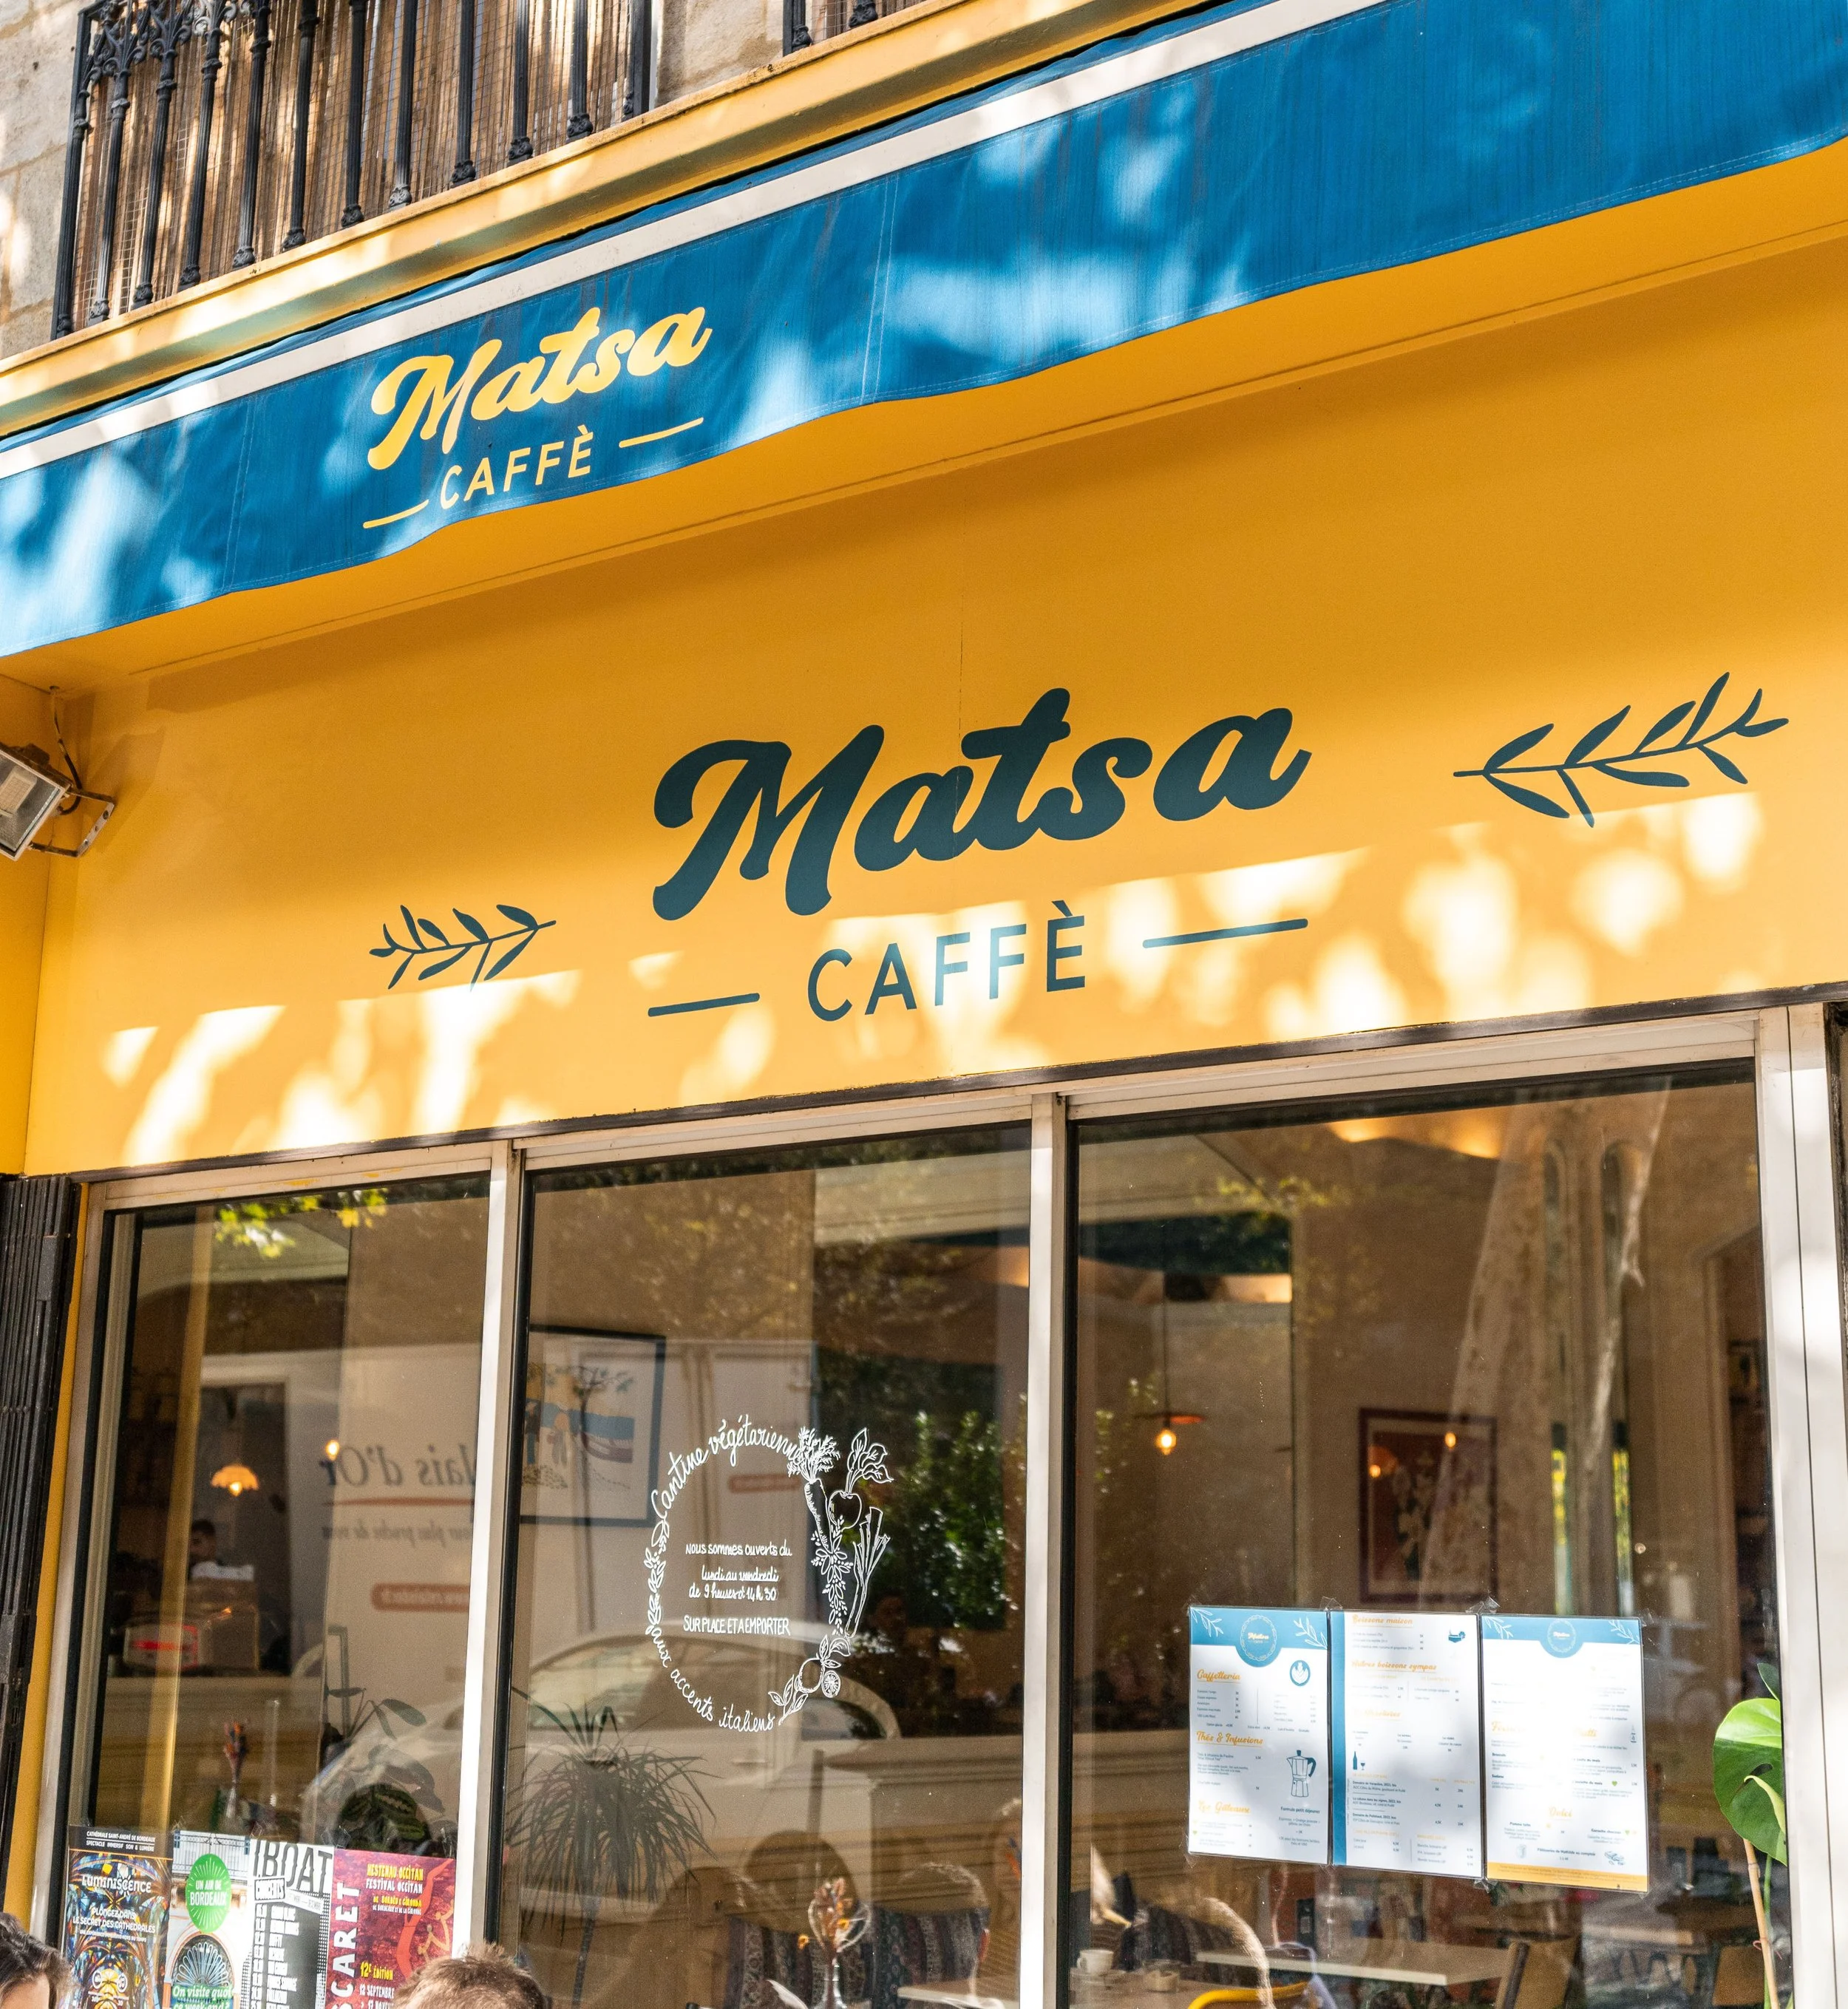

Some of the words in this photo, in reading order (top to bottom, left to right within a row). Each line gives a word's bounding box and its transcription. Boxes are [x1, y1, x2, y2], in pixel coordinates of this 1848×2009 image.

[367, 307, 713, 470] Matsa
[440, 424, 594, 509] CAFFÈ
[653, 688, 1312, 921] Matsa
[806, 900, 1085, 1022] CAFFÈ
[650, 1447, 710, 1519] Cantine
[707, 1544, 743, 1556] sommes
[744, 1541, 778, 1557] ouverts
[779, 1539, 793, 1557] du
[689, 1582, 701, 1599] de
[704, 1583, 710, 1599] 9
[683, 1614, 702, 1633] SUR
[702, 1617, 726, 1634] PLACE
[727, 1617, 738, 1634] ET
[744, 1617, 791, 1636] EMPORTER
[1352, 1614, 1385, 1624] Boissons
[651, 1627, 672, 1668] aux
[1197, 1668, 1242, 1682] Caffetteria
[1377, 1661, 1407, 1669] boissons
[1408, 1663, 1437, 1673] sympas
[670, 1669, 713, 1721] accents
[719, 1703, 775, 1733] italiens
[1195, 1730, 1214, 1743] Thés
[1216, 1732, 1223, 1743] &
[1225, 1733, 1264, 1746] Infusions
[108, 1832, 131, 1840] SAINT-ANDRÉ
[398, 1865, 424, 1881] OCCITAN
[195, 1880, 204, 1891] UN
[204, 1880, 214, 1891] AIR
[214, 1880, 222, 1891] DE
[365, 1877, 395, 1891] FESTIVAL
[397, 1880, 423, 1894] OCCITAN
[190, 1891, 227, 1906] BORDEAUX
[72, 1916, 80, 1924] LE
[80, 1917, 102, 1926] SECRET
[102, 1920, 115, 1928] DES
[92, 1907, 118, 1918] PLONGEZ
[119, 1910, 137, 1920] DANS
[173, 1985, 186, 1997] On
[186, 1984, 211, 1997] visite
[211, 1984, 233, 2001] quoi
[367, 1984, 395, 1999] SEPTEMBRE
